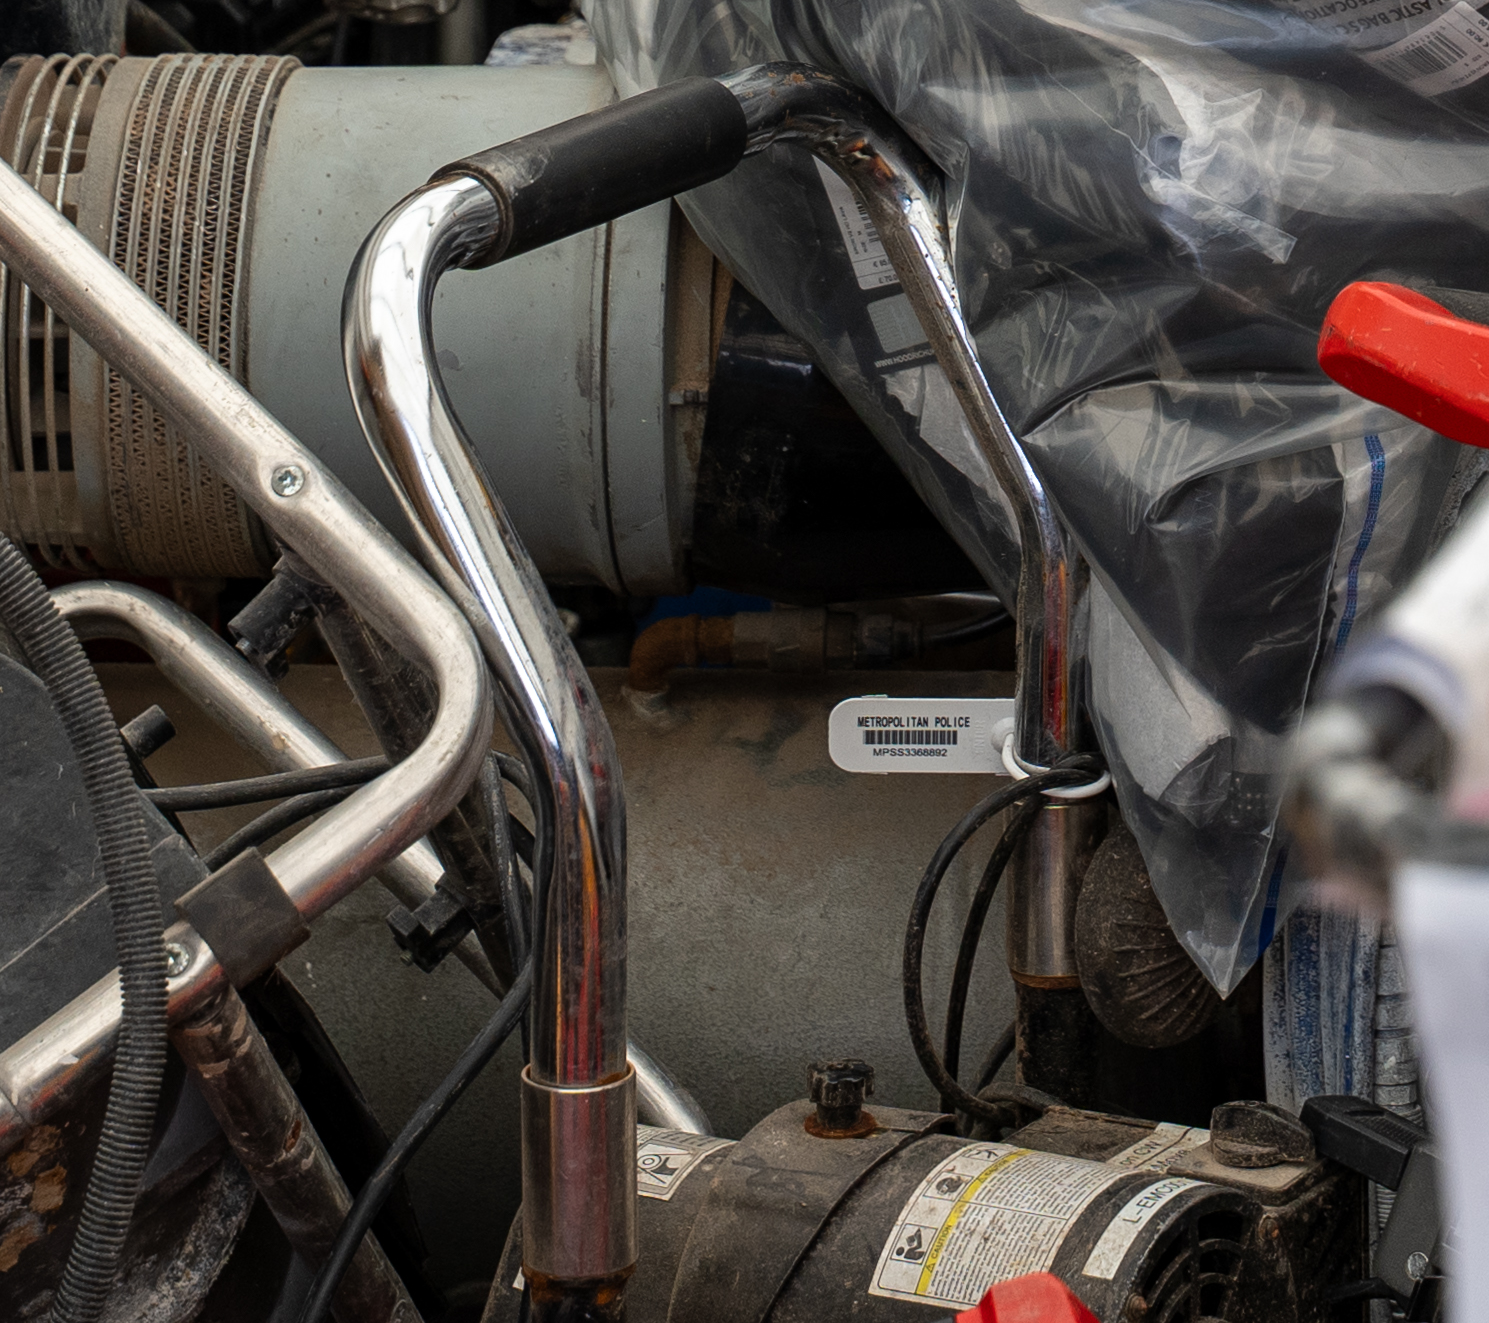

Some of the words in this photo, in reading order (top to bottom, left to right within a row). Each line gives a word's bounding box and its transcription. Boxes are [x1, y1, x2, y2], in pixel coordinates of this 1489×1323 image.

[1346, 5, 1390, 37] BAGS
[873, 347, 935, 369] WWW.HOODRICHU
[856, 716, 928, 728] METROPOLITAN
[934, 716, 970, 728] POLICE
[872, 747, 948, 757] MPSS3368892
[932, 1224, 953, 1260] CAUTION
